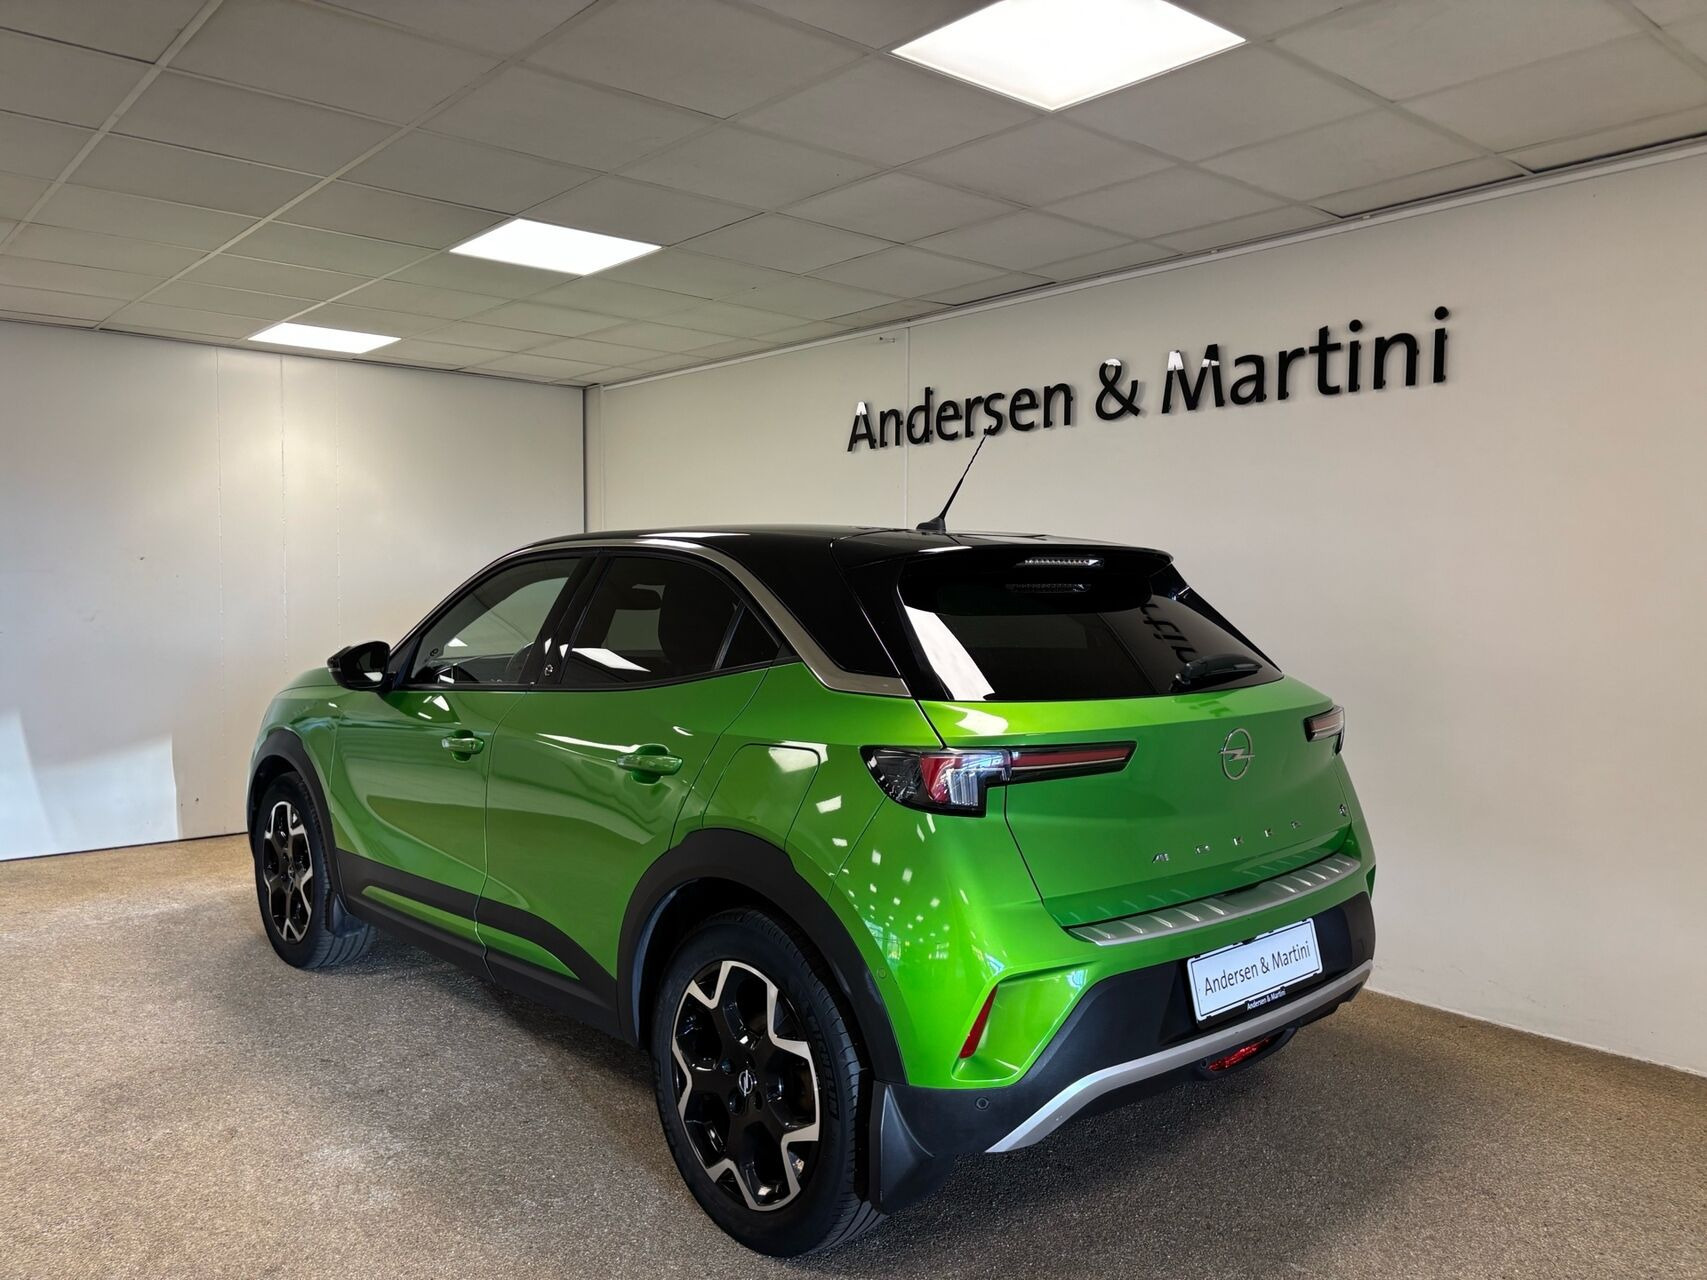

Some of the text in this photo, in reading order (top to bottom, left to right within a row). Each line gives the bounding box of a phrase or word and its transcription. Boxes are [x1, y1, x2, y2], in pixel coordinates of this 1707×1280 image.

[847, 306, 1449, 452] Andersen & Martini
[1204, 941, 1311, 996] Andersen & Martini
[1247, 998, 1267, 1011] Andersen
[1271, 989, 1286, 1000] Martini
